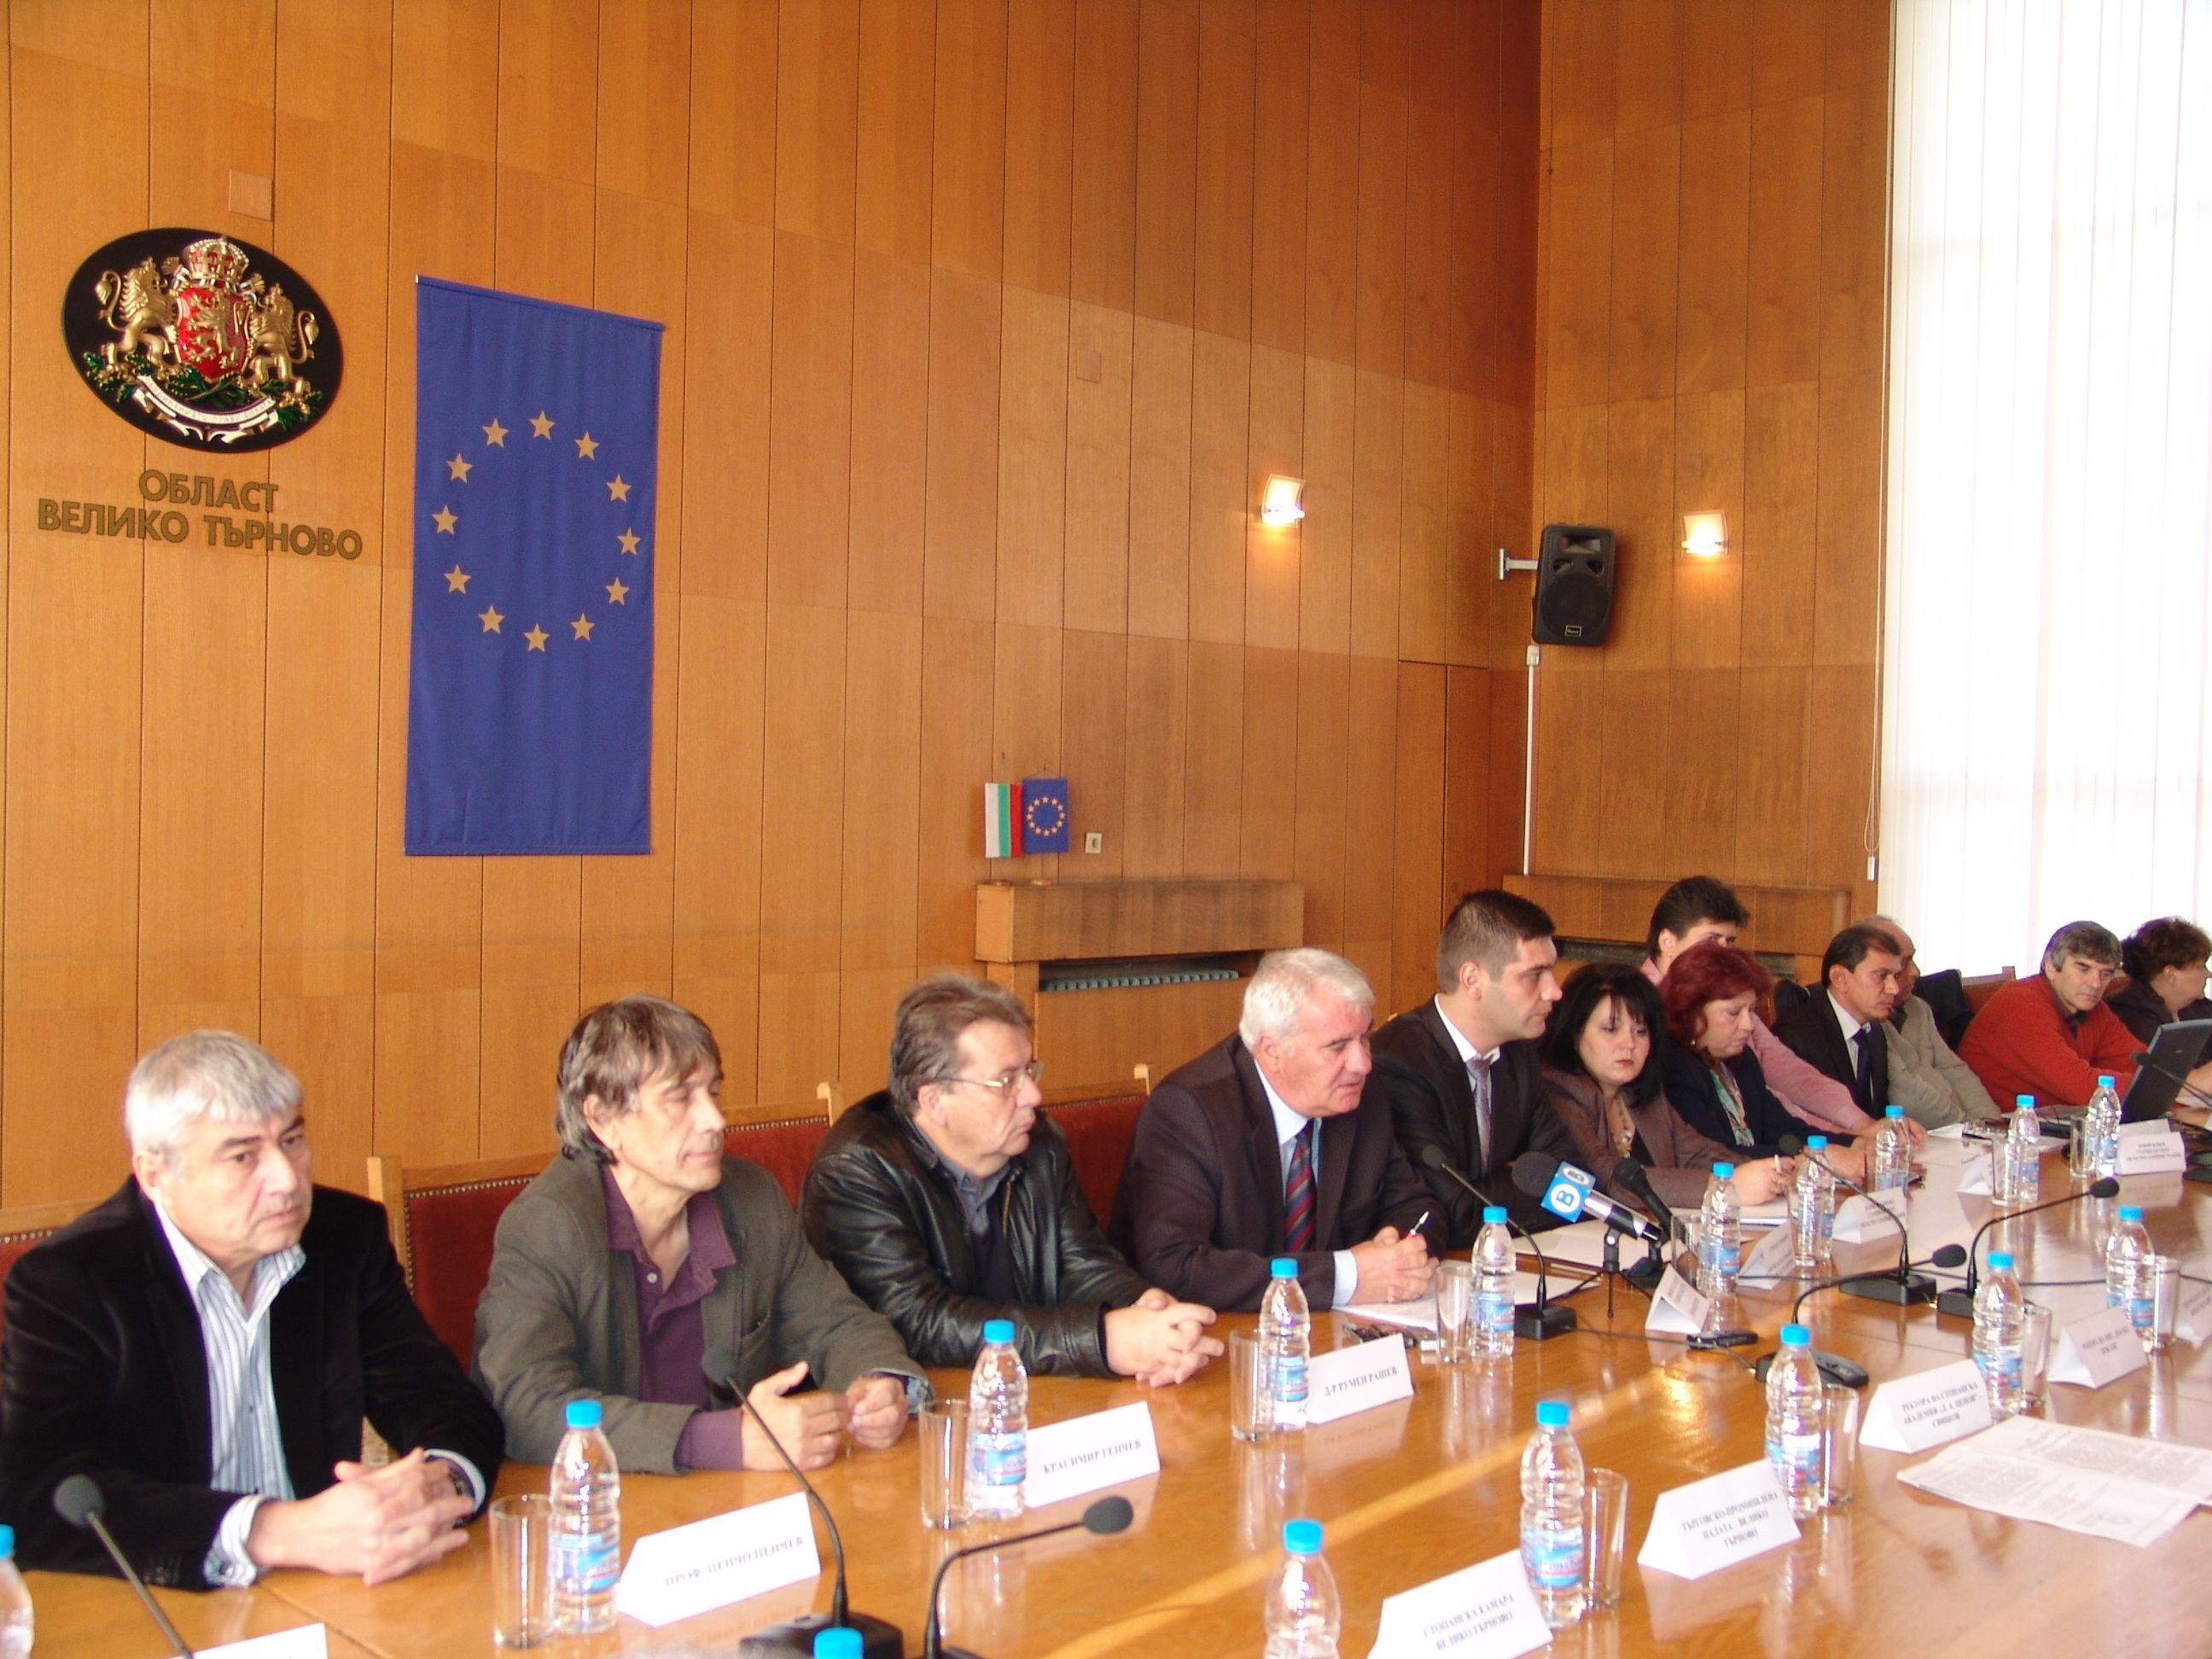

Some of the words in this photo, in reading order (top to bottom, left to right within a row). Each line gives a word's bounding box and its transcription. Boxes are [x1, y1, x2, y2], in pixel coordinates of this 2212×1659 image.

[138, 469, 279, 514] ОБЛАСТ
[38, 498, 189, 544] ВЕЛИКО
[203, 515, 364, 561] ТЪРНОВО
[1338, 1374, 1368, 1392] РУМЕН
[1368, 1365, 1398, 1382] РАШЕВ
[1043, 1450, 1100, 1475] КРАСИМИР
